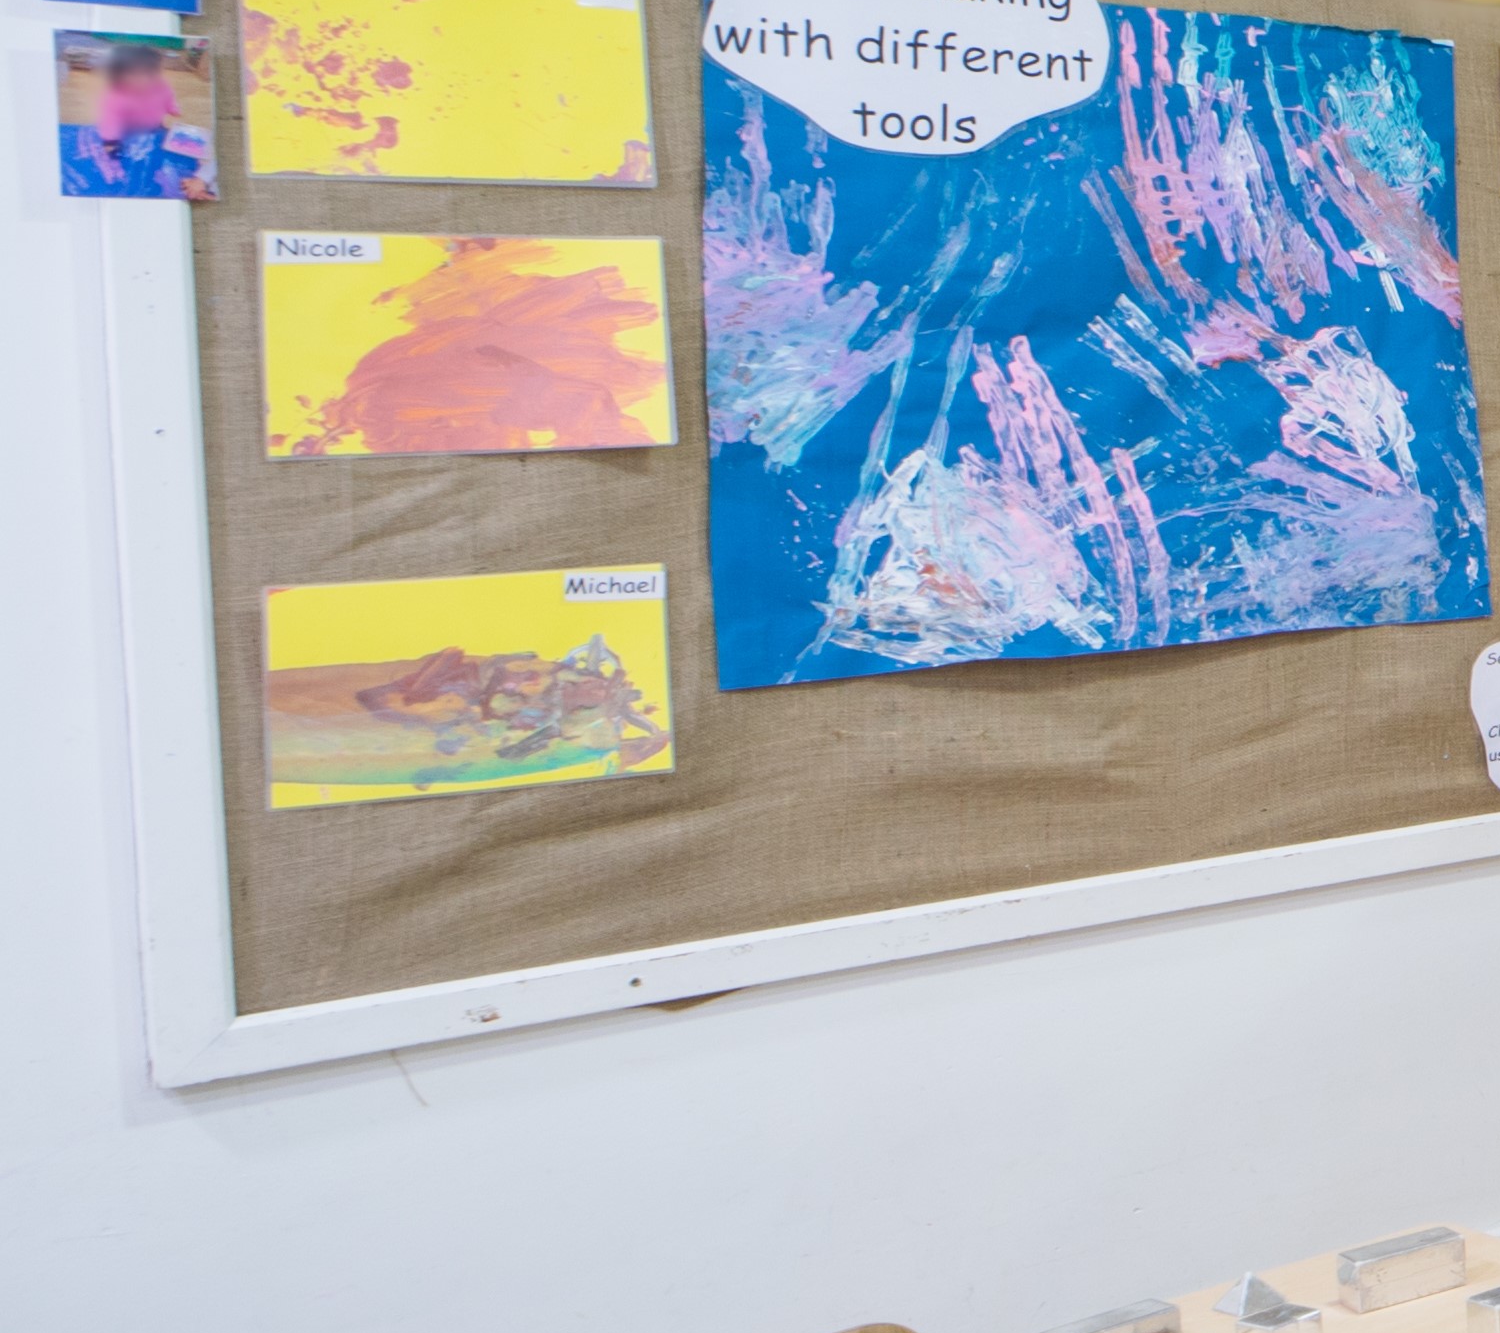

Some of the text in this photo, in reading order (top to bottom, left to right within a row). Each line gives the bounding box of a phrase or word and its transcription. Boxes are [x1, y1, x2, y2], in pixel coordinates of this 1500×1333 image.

[715, 18, 1092, 82] with different
[853, 103, 976, 143] tools
[276, 238, 363, 258] Nicole
[565, 576, 656, 594] Michael
